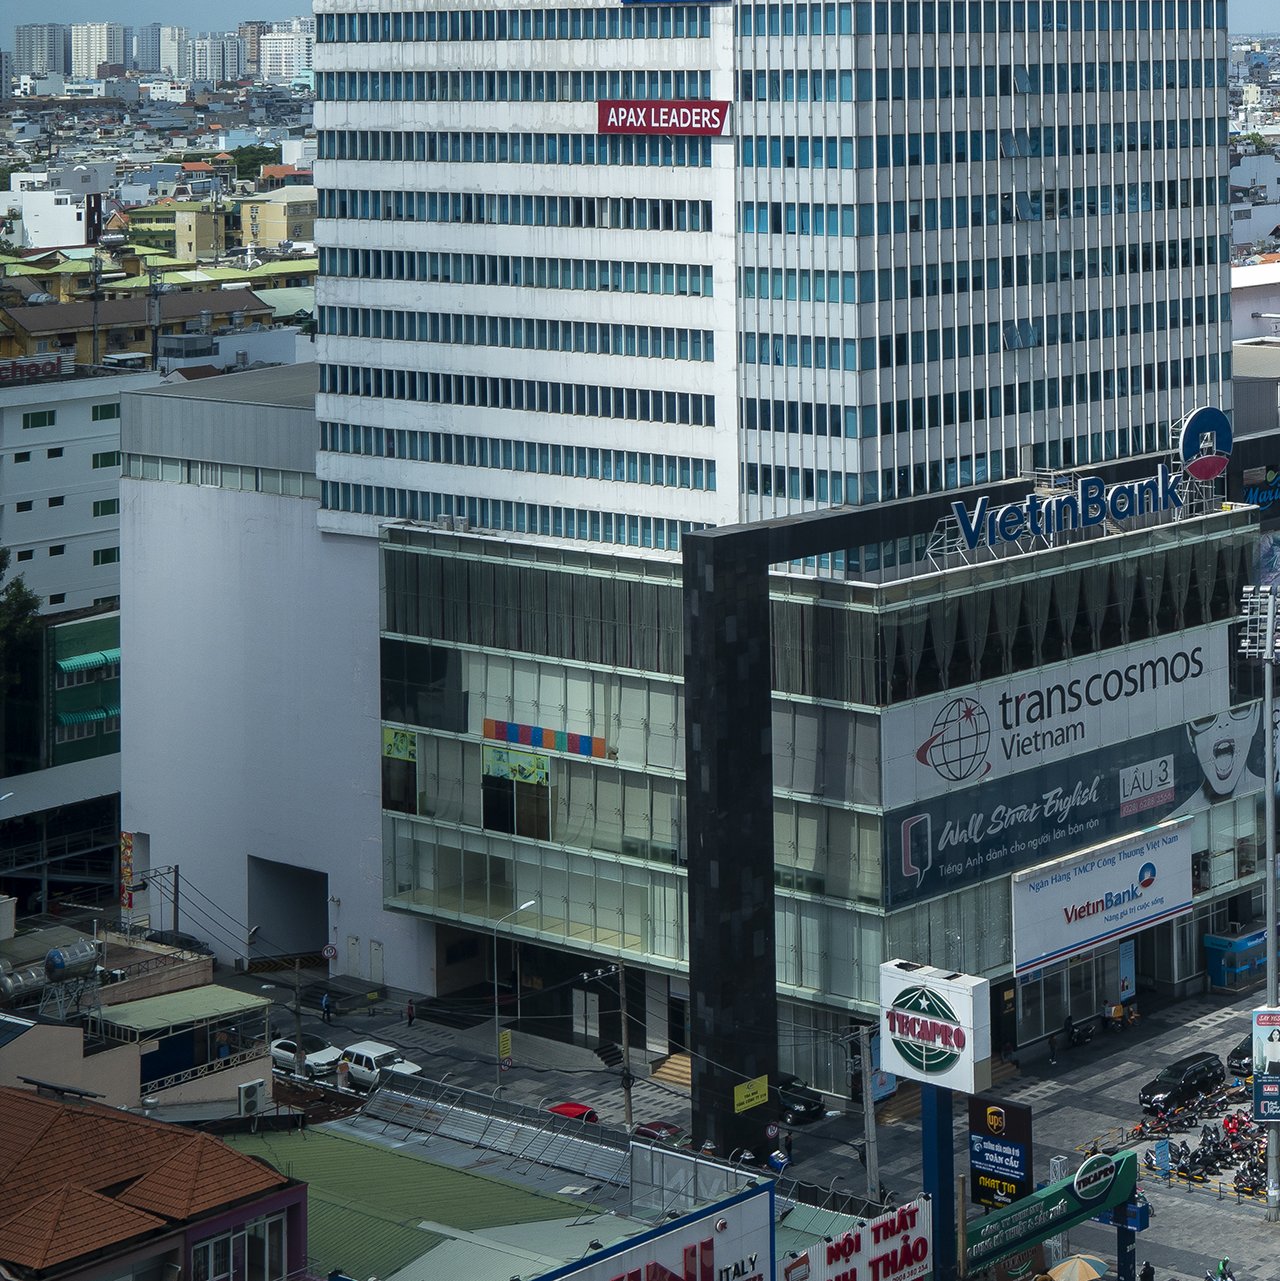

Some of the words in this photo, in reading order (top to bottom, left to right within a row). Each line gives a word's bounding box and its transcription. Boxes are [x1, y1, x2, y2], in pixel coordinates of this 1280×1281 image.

[607, 107, 647, 127] APAX
[651, 108, 720, 129] LEADERS
[951, 463, 1184, 551] VietinBank
[998, 646, 1204, 731] transcosmos
[1000, 719, 1086, 762] Vietnam
[1122, 767, 1153, 798] LẦU
[1158, 759, 1169, 783] 3
[937, 812, 985, 852] Wall
[986, 802, 1043, 835] Street
[1042, 775, 1100, 823] English
[939, 862, 963, 877] Tiếng
[965, 852, 984, 869] Anh
[985, 845, 1008, 862] dành
[1009, 839, 1026, 854] cho
[1027, 833, 1052, 850] người
[1052, 828, 1066, 841] lớn
[1086, 818, 1100, 832] rộn
[1028, 879, 1050, 894] Ngân
[1050, 870, 1072, 886] Hàng
[1072, 861, 1096, 877] TMCP
[1096, 857, 1117, 870] Công
[1146, 841, 1161, 852] Việt
[1161, 834, 1179, 846] Nam
[1063, 883, 1140, 925] VietinBank
[886, 1010, 967, 1050] TECAPRO
[988, 1113, 1004, 1130] ups
[984, 1152, 1004, 1164] TOÀN
[1075, 1164, 1116, 1190] TECAPRO
[826, 1231, 862, 1265] NỘI
[871, 1204, 919, 1245] THẤT
[718, 1251, 758, 1281] ITALY
[868, 1234, 928, 1281] THẢO
